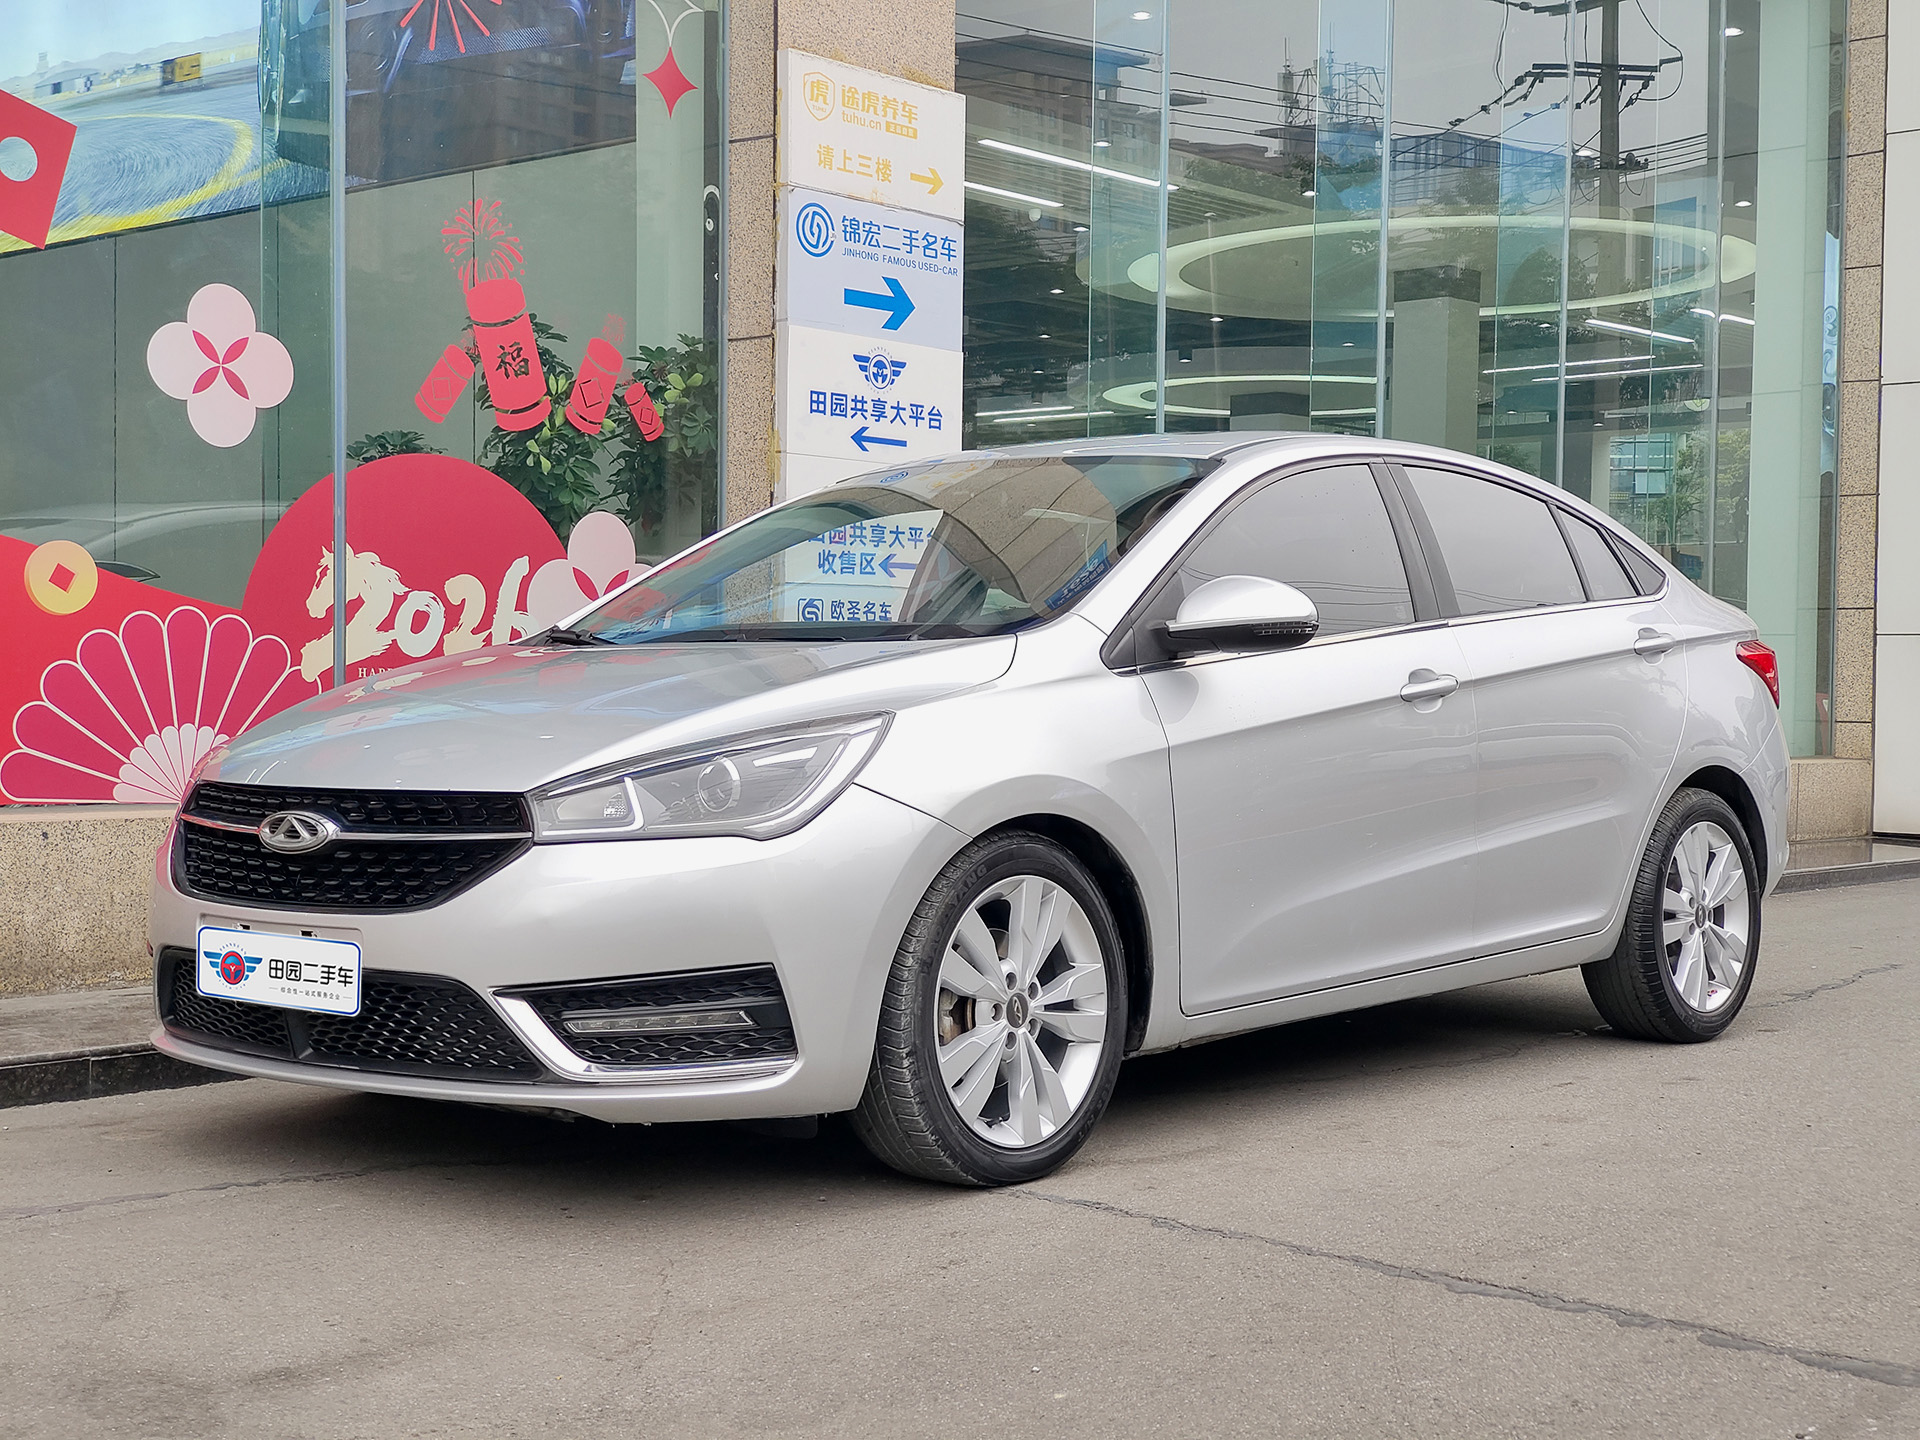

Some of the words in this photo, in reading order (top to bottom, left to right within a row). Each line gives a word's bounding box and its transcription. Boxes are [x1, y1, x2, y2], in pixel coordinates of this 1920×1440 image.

[810, 80, 829, 105] 虎
[841, 85, 918, 124] 途虎养车
[842, 110, 881, 130] tuhu.cn
[817, 144, 892, 183] 请上三楼
[841, 215, 957, 262] 锦宏二手名车
[842, 248, 879, 261] JINHONG
[883, 255, 916, 268] FAMOUS
[919, 261, 958, 276] USED-CAR
[496, 341, 531, 380] 福
[809, 390, 943, 431] 田园共享大平台
[817, 549, 877, 575] 收售区
[301, 541, 541, 682] 2026
[830, 600, 893, 621] 欧圣名车
[268, 959, 354, 987] 田园二手车
